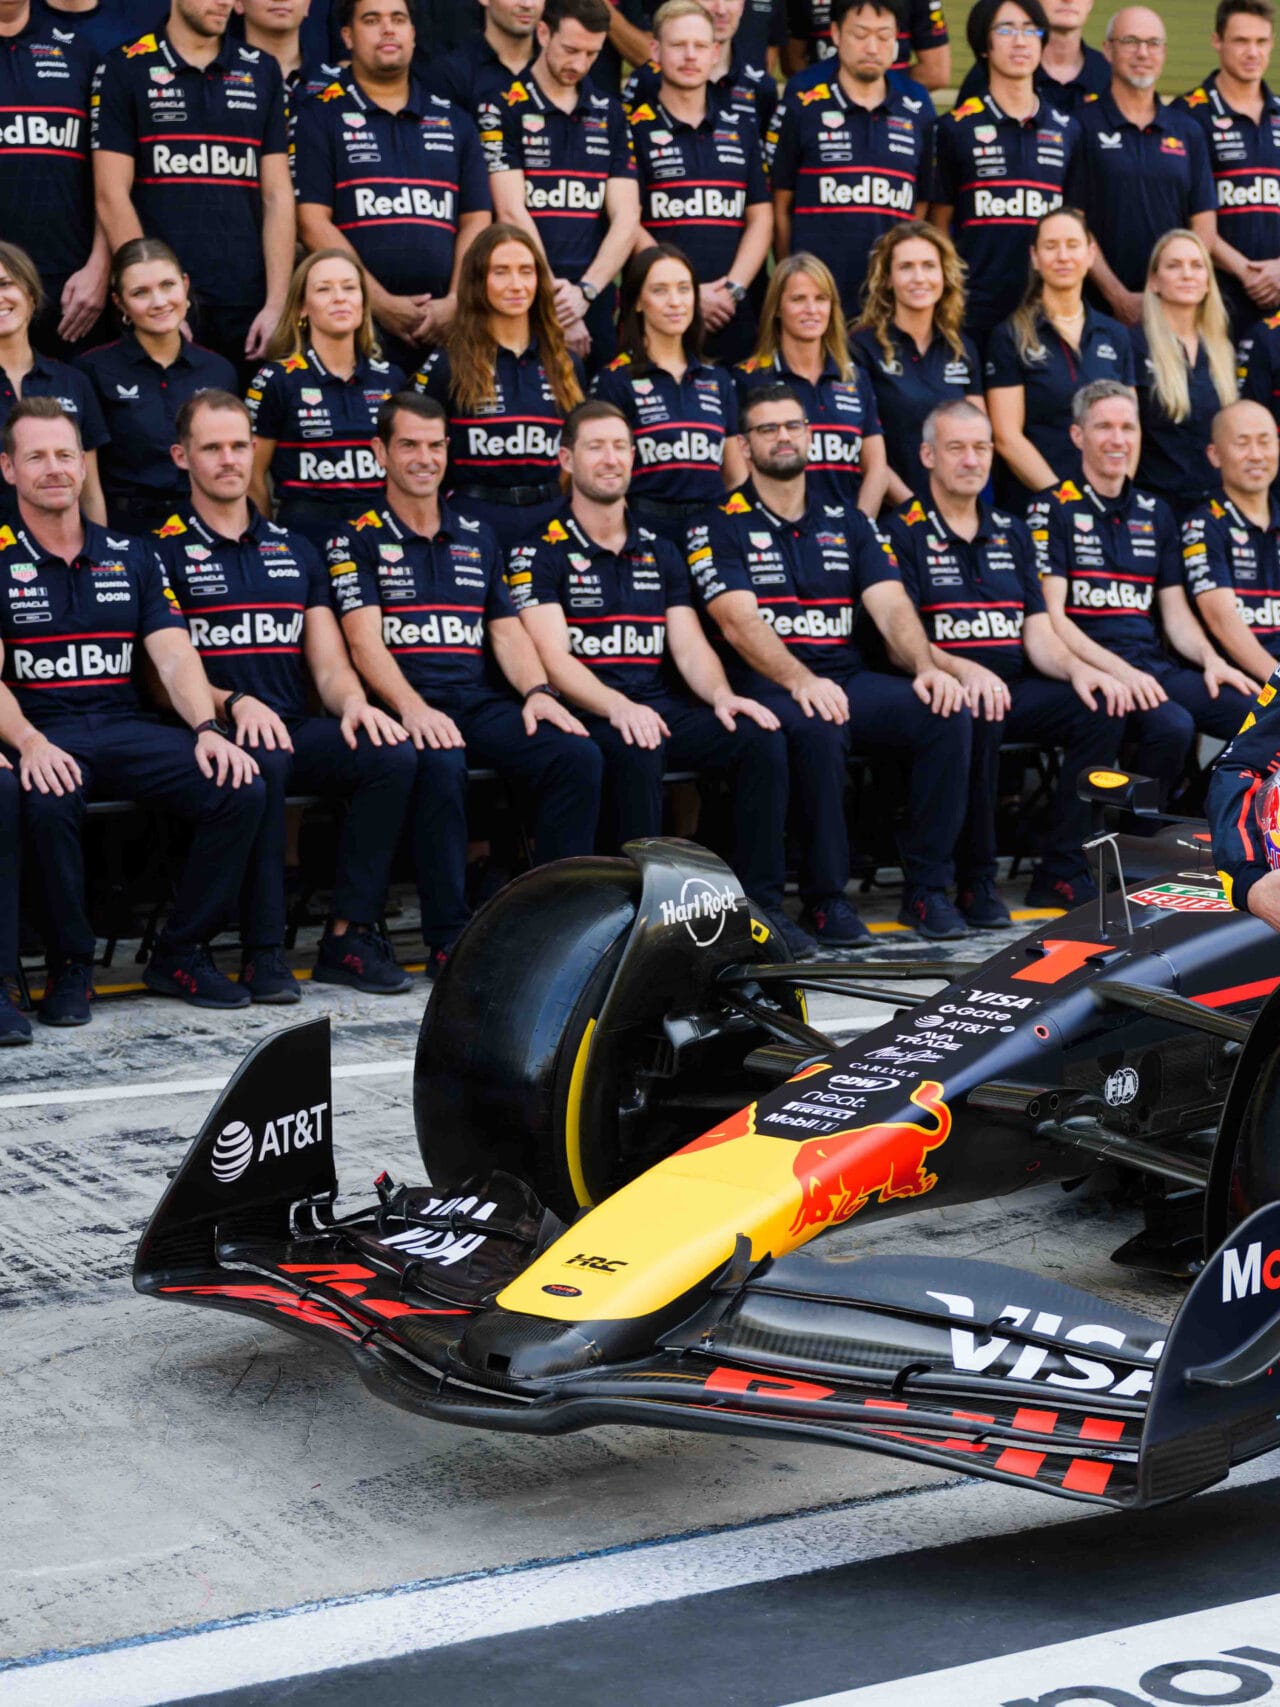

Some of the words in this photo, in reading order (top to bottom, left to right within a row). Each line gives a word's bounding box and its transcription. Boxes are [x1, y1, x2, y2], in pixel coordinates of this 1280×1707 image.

[1173, 885, 1227, 899] TA
[701, 885, 738, 920] Rock
[1010, 939, 1117, 984] 1
[969, 988, 1034, 1010] VISA
[955, 1007, 1012, 1021] Gate
[941, 1020, 997, 1034] AT&T
[895, 1034, 964, 1051] TRADE
[914, 1031, 955, 1042] AVA
[848, 1062, 920, 1079] CARLYLE
[828, 1074, 886, 1089] CDW
[1106, 1075, 1137, 1101] FIA
[782, 1101, 857, 1120] PIRELLI
[763, 1112, 817, 1130] Mobil
[259, 1102, 328, 1162] AT&T
